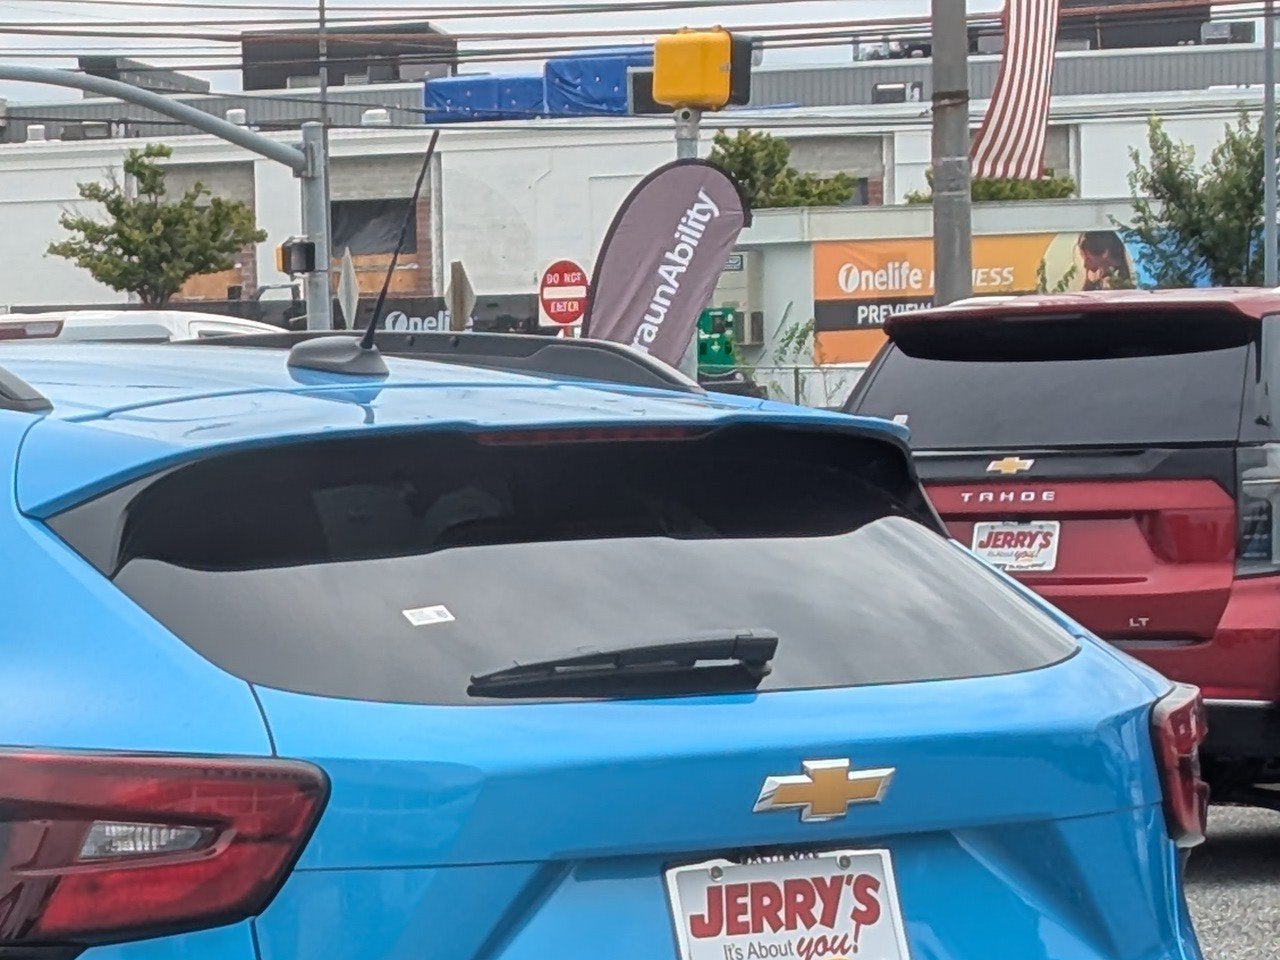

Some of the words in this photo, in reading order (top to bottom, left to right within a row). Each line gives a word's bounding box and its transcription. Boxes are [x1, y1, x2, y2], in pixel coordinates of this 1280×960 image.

[546, 273, 560, 284] DO
[564, 272, 582, 283] NOT
[631, 188, 720, 354] raunAbility
[838, 261, 923, 293] Onelife
[550, 301, 579, 313] ENTER
[385, 310, 473, 332] Oneli
[961, 491, 1056, 502] TAHOE
[978, 530, 1053, 549] JERRY'S
[1129, 617, 1150, 627] LT
[689, 873, 881, 939] JERRY'S
[747, 940, 794, 960] About
